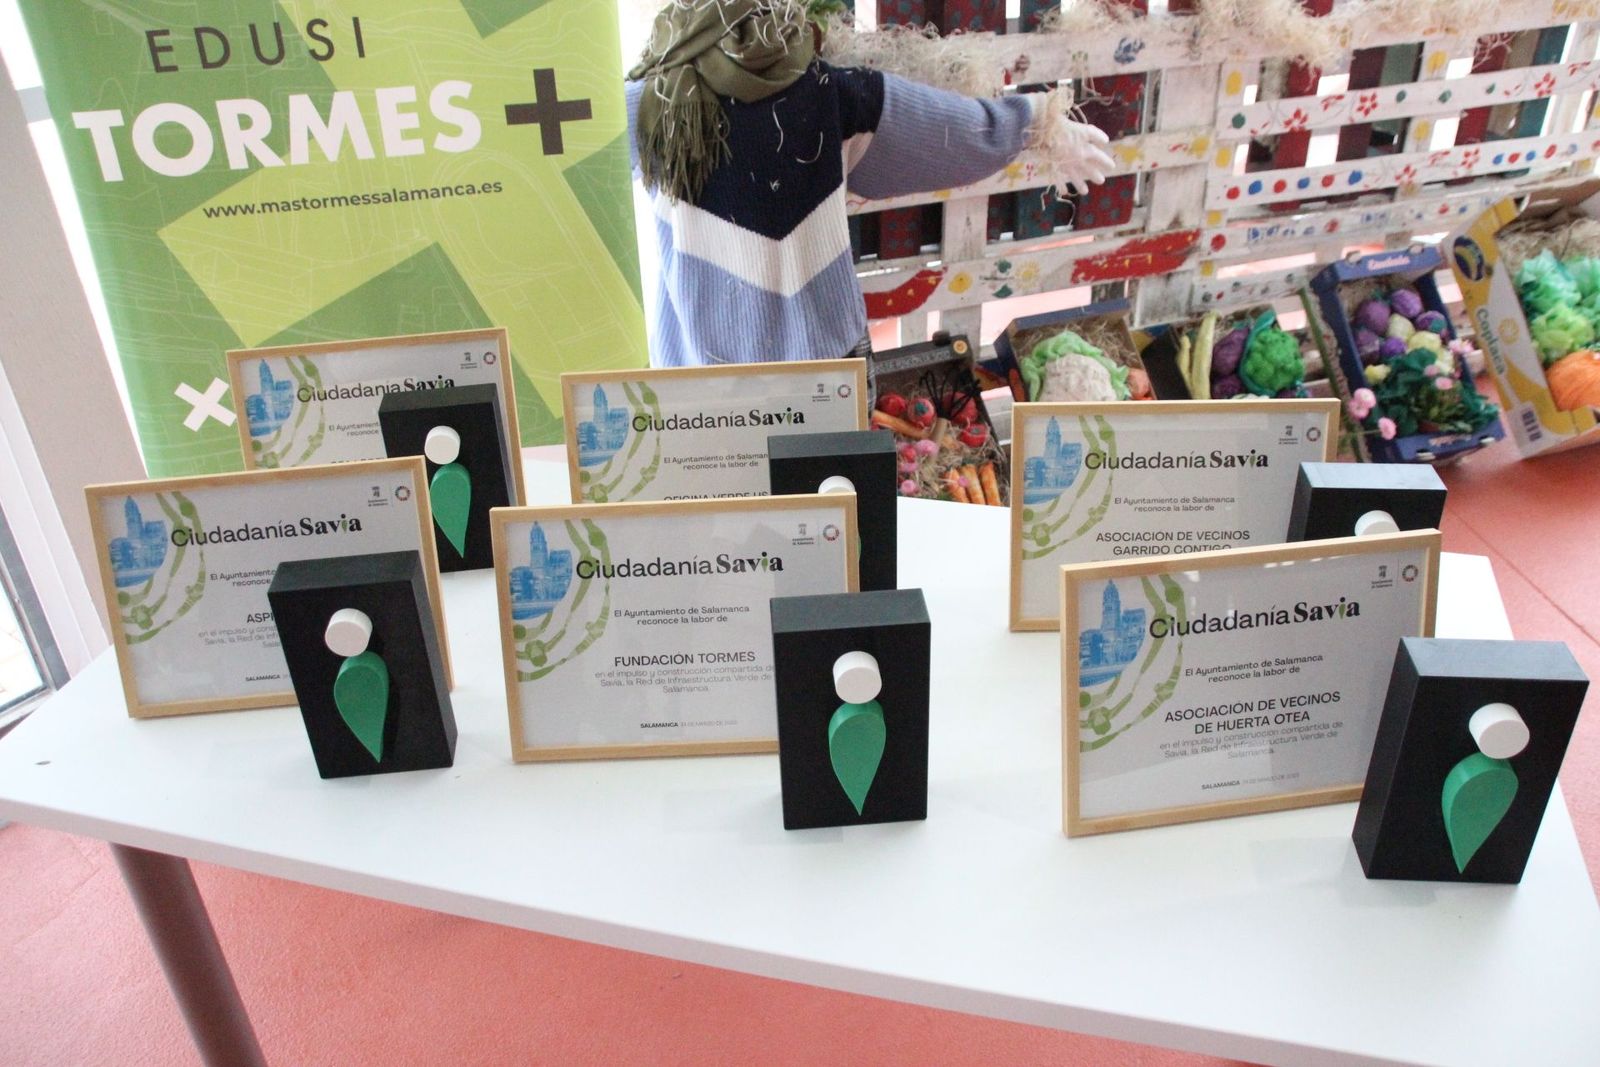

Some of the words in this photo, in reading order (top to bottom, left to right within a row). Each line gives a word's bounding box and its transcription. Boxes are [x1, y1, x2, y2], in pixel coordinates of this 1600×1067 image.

[145, 16, 366, 73] EDUSI
[72, 80, 483, 182] TORMES
[203, 180, 503, 221] www.mastormessalamanca.es
[403, 374, 455, 392] Savia
[336, 422, 379, 432] Ayuntamient
[632, 410, 746, 433] Ciudadanía
[748, 407, 805, 426] Savia
[672, 455, 724, 465] Ayuntamiento
[737, 452, 768, 461] Salaman
[683, 463, 718, 471] reconoce
[728, 461, 747, 469] labor
[749, 460, 759, 468] de
[1084, 450, 1206, 471] Ciudadanía
[1209, 449, 1269, 469] Savia
[1123, 497, 1179, 506] Ayuntamiento
[1180, 496, 1191, 504] de
[1192, 496, 1235, 504] Salamanca
[1182, 504, 1203, 512] labor
[171, 519, 298, 548] Ciudadanía
[299, 513, 362, 536] Savia
[1177, 531, 1193, 541] DE
[1196, 530, 1250, 541] VECINOS
[1113, 545, 1170, 556] GARRIDO
[576, 555, 713, 580] Ciudadanía
[716, 551, 784, 574] Savia
[232, 579, 271, 587] reconoce
[624, 607, 686, 619] Ayuntamiento
[688, 606, 699, 615] de
[701, 605, 750, 614] Salamanca
[1149, 605, 1291, 639] Ciudadanía
[1293, 597, 1361, 623] Savia
[637, 616, 679, 626] reconoce
[690, 615, 714, 624] labor
[716, 614, 727, 622] de
[698, 651, 756, 664] TORMES
[607, 670, 615, 678] el
[616, 669, 647, 679] impulso
[649, 670, 656, 679] y
[713, 665, 763, 675] compartida
[1185, 668, 1194, 677] El
[1195, 662, 1259, 677] Ayuntamiento
[1260, 659, 1273, 669] de
[1274, 654, 1324, 666] Salamanca
[655, 677, 666, 685] de
[667, 675, 731, 685] Infraestructura
[734, 674, 759, 682] Verde
[1208, 672, 1251, 684] reconoce
[1253, 670, 1262, 679] la
[1263, 667, 1288, 678] labor
[1288, 665, 1301, 674] de
[1258, 699, 1276, 711] DE
[1280, 691, 1341, 708] VECINOS
[1194, 723, 1213, 735] DE
[1217, 715, 1270, 732] HUERTA
[1274, 710, 1311, 725] OTEA
[1173, 740, 1180, 748] el
[1280, 722, 1330, 737] compartida
[1332, 720, 1344, 728] de
[1301, 732, 1325, 741] Verde
[1326, 730, 1338, 738] de
[1201, 779, 1241, 790] SALAMANCA
